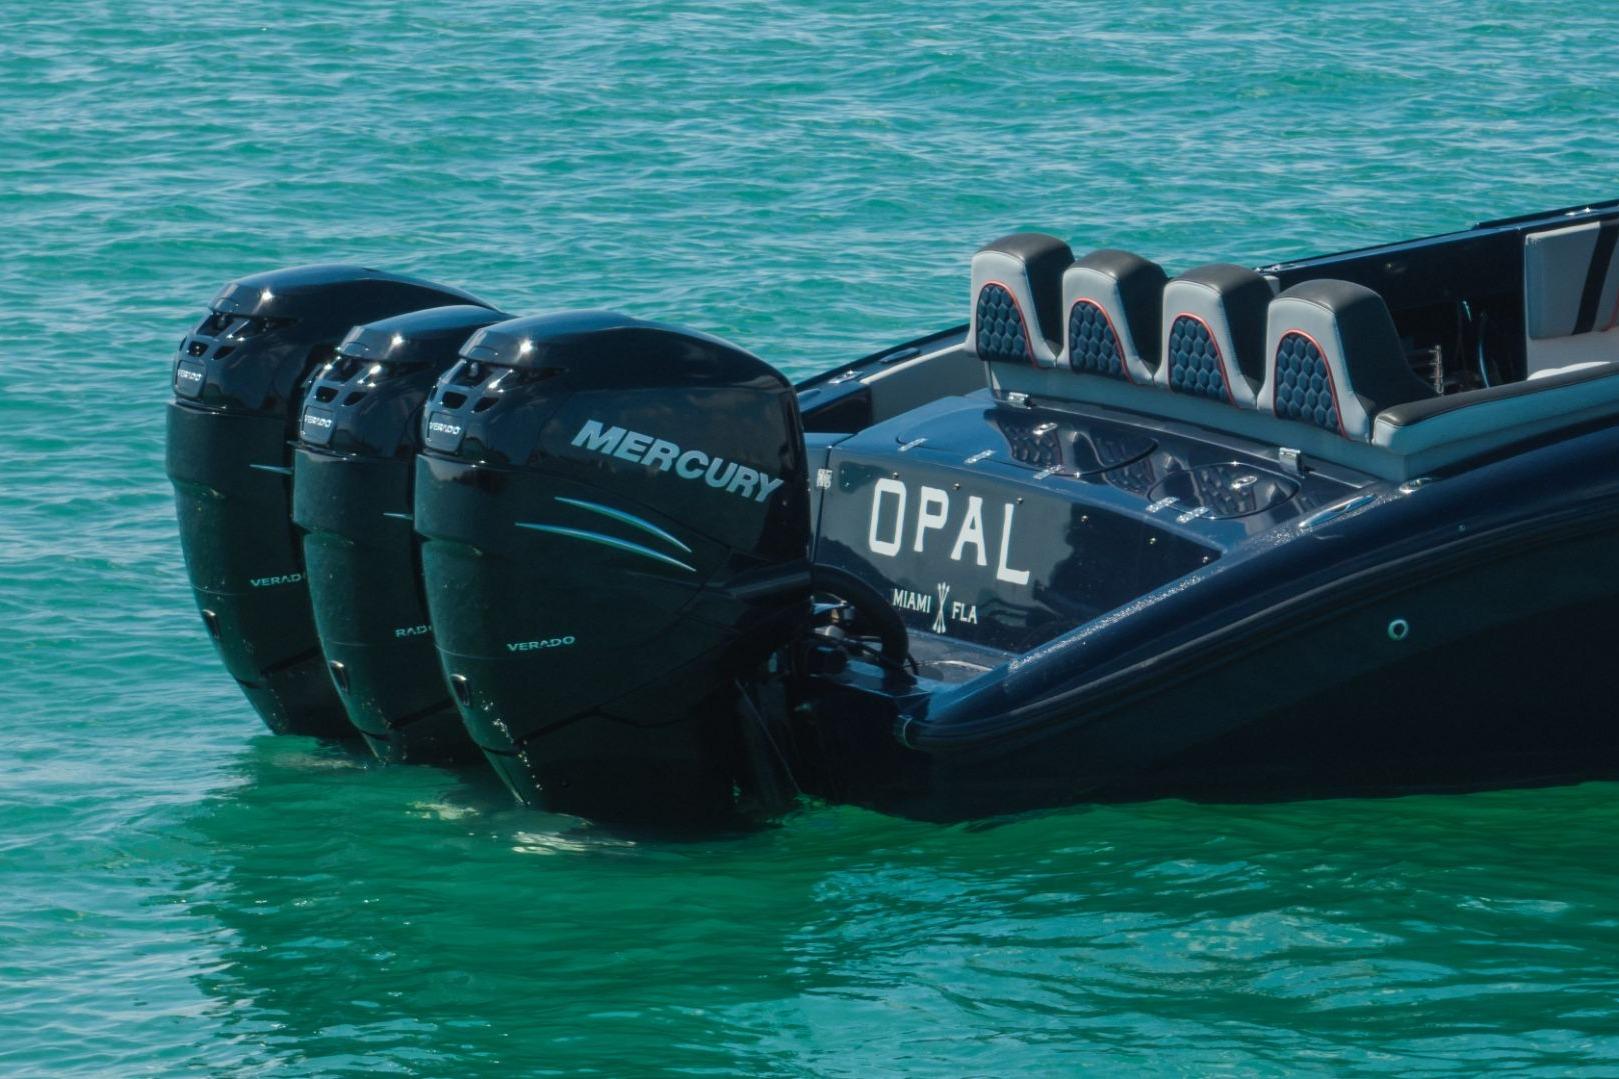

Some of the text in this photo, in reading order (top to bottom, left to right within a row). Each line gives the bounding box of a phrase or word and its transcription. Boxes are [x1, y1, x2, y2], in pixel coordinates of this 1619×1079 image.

[429, 422, 461, 435] VERADO
[571, 419, 784, 502] MERCURY
[869, 478, 1030, 585] OPAL
[250, 573, 306, 587] VERAD
[892, 588, 977, 624] MIAMI FLA
[506, 636, 576, 651] VERADO
